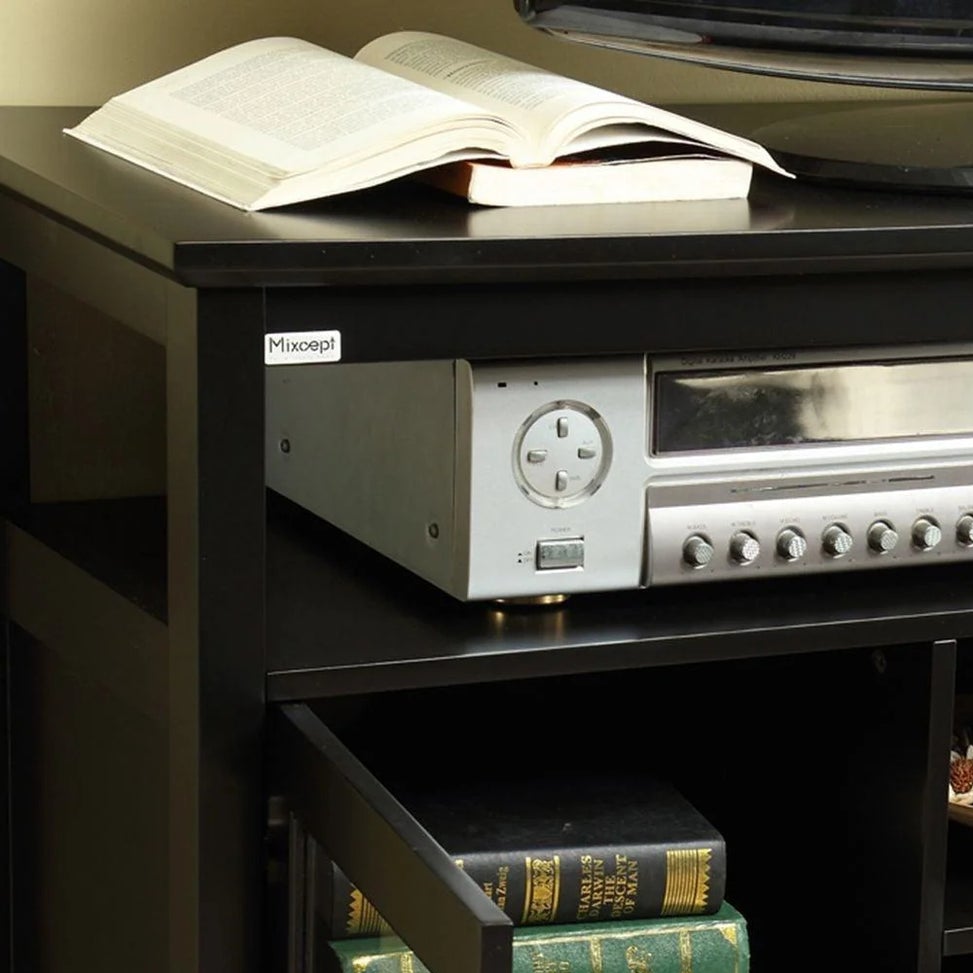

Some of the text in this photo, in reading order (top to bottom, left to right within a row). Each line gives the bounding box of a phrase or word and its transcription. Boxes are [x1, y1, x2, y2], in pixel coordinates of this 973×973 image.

[269, 336, 336, 354] Mixcept
[576, 854, 592, 921] CHARLES
[589, 858, 605, 918] DARWIN
[603, 875, 616, 905] THE
[611, 853, 628, 919] DESCENT
[623, 860, 639, 915] OF MAN
